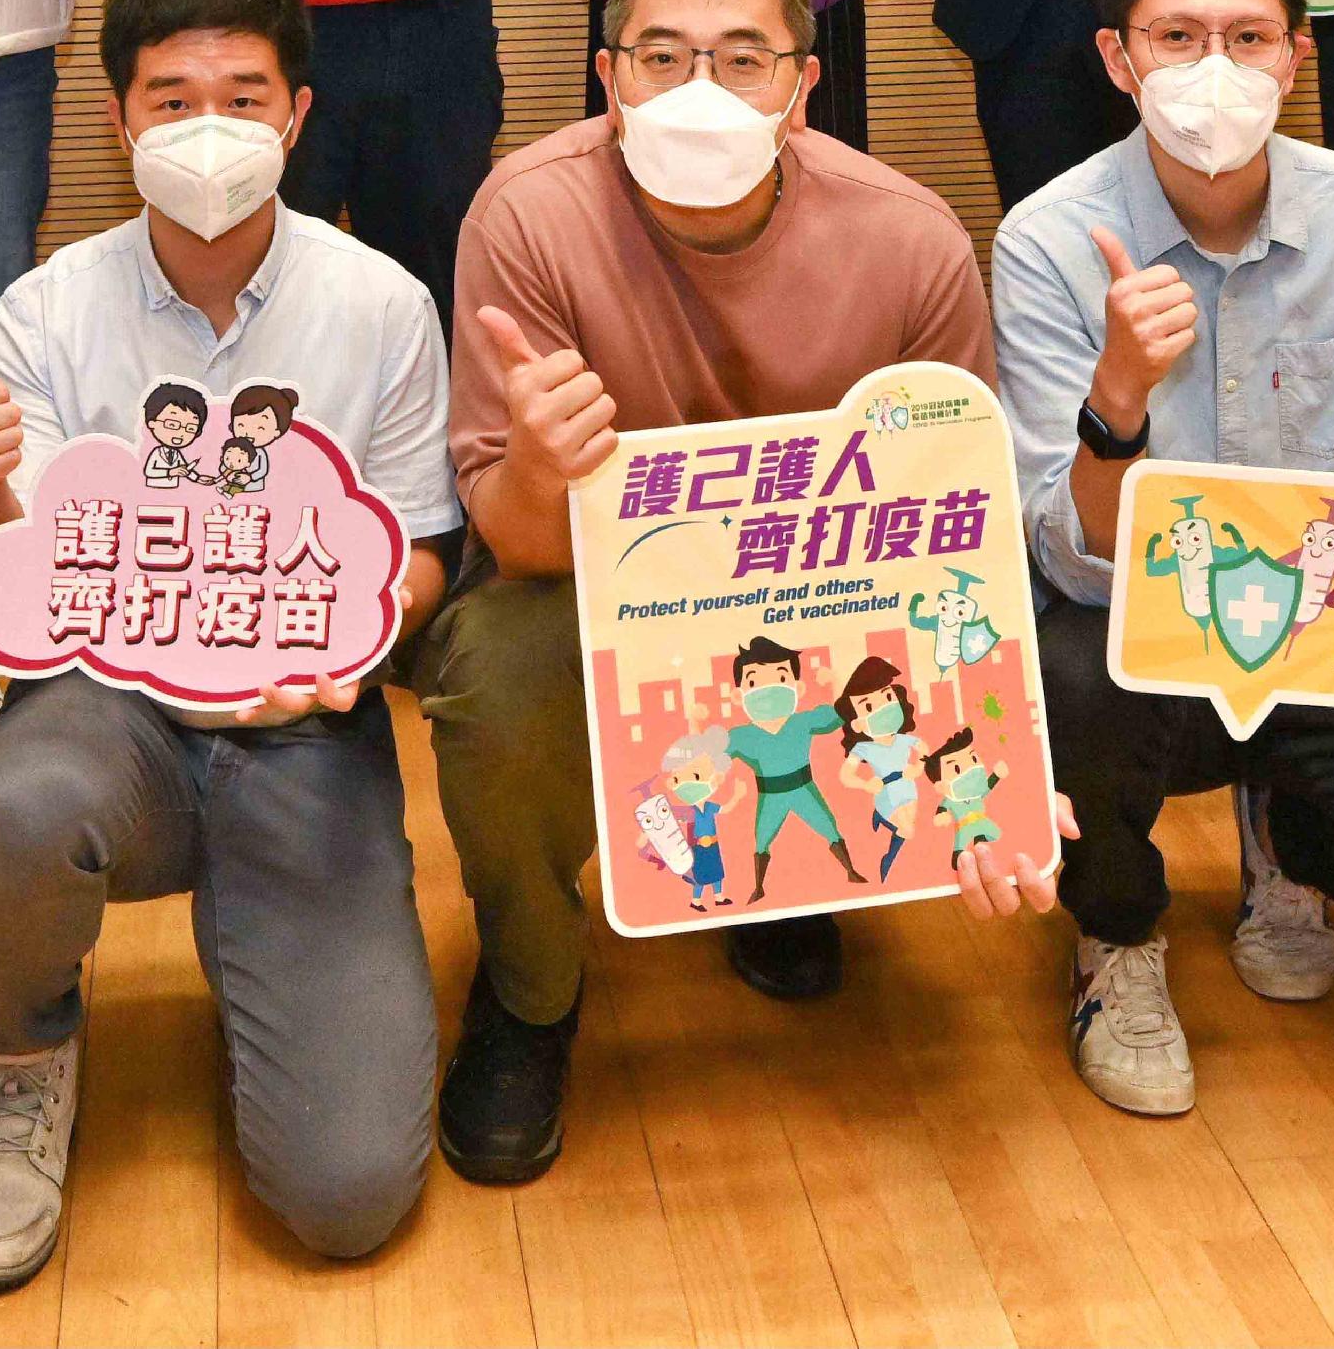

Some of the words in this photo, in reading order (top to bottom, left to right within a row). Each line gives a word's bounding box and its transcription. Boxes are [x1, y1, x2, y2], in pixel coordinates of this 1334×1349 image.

[618, 430, 876, 520] 護己護人
[53, 498, 341, 577] 護己護人
[731, 488, 991, 579] 齊打疫苗
[48, 572, 338, 650] 齊打疫苗
[618, 597, 687, 621] Protect
[691, 588, 769, 616] yourself
[774, 583, 810, 602] and
[815, 578, 874, 597] others
[763, 606, 795, 624] Get
[800, 592, 900, 619] vaccinated
